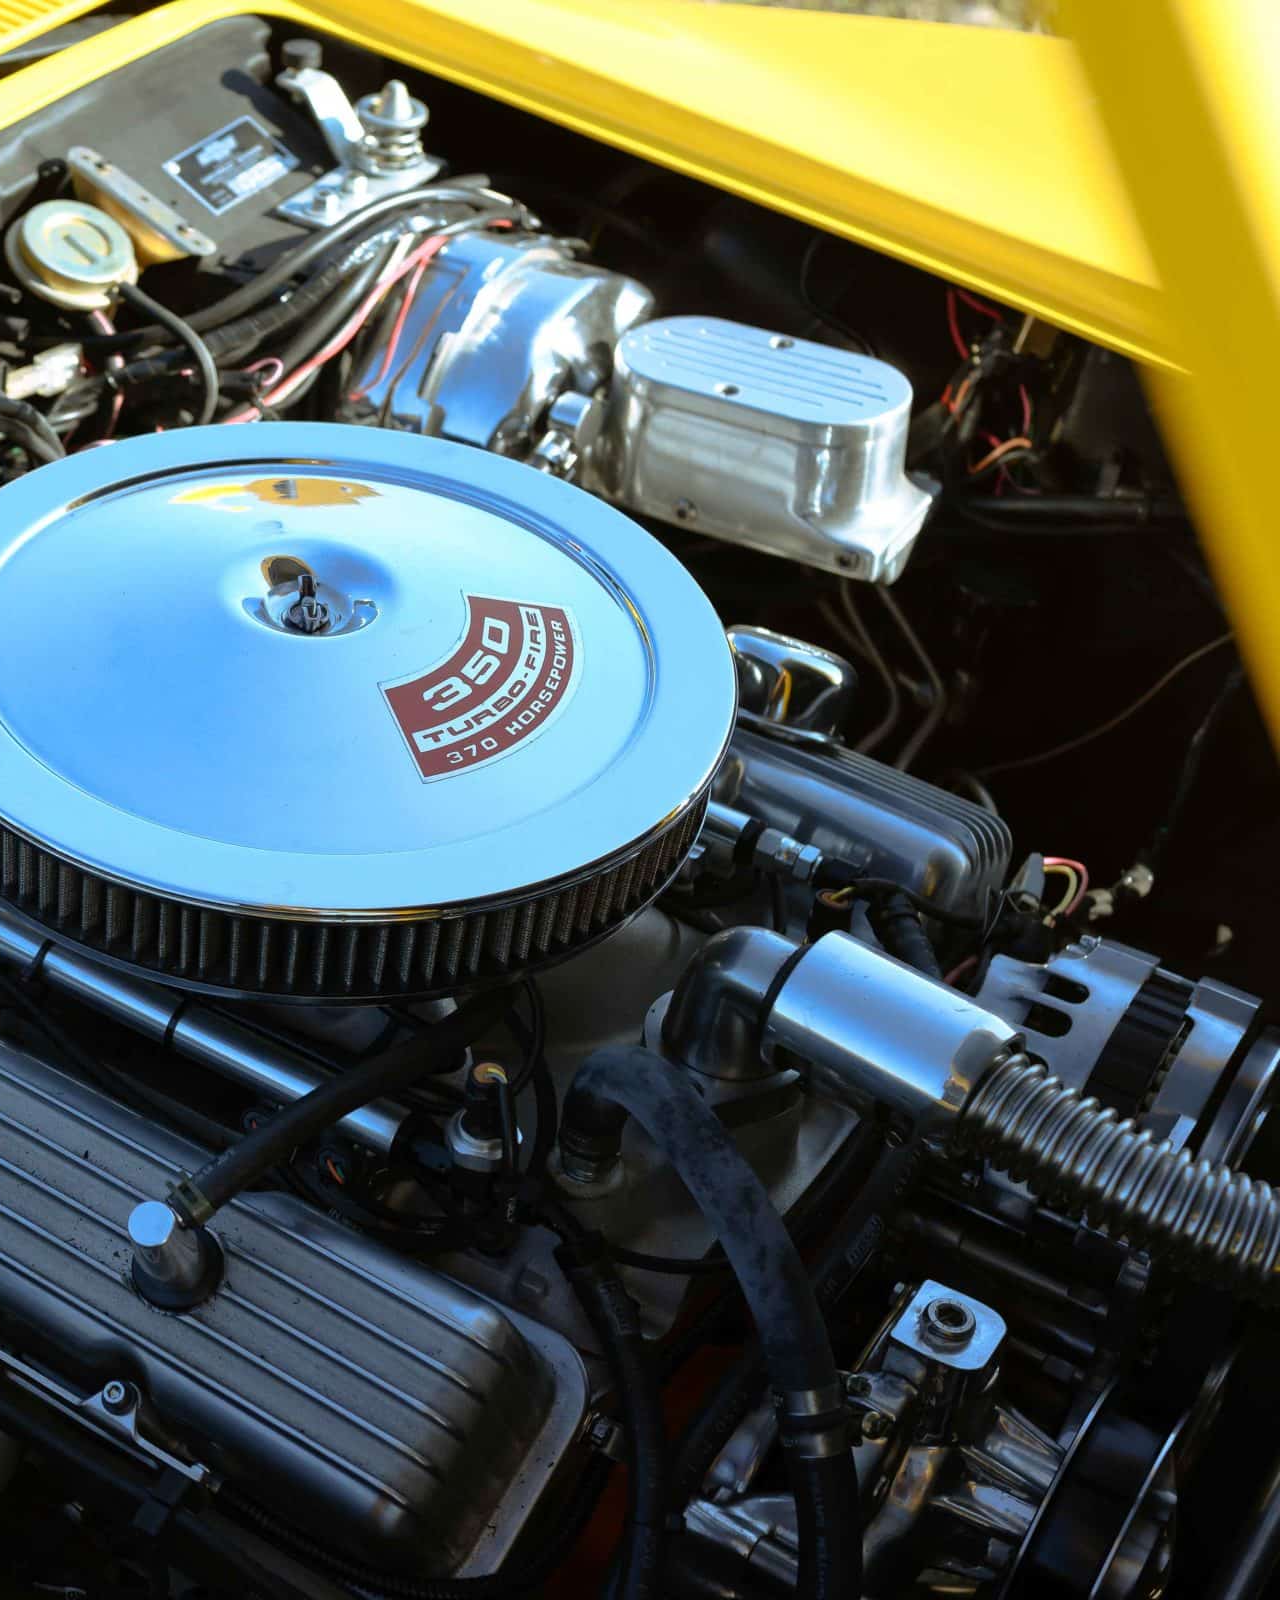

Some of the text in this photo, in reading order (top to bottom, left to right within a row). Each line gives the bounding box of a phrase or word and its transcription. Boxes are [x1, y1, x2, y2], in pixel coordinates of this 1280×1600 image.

[422, 616, 510, 711] 350
[422, 611, 541, 743] TURBO-FIRE
[446, 619, 567, 764] 370 HORSEPOWER
